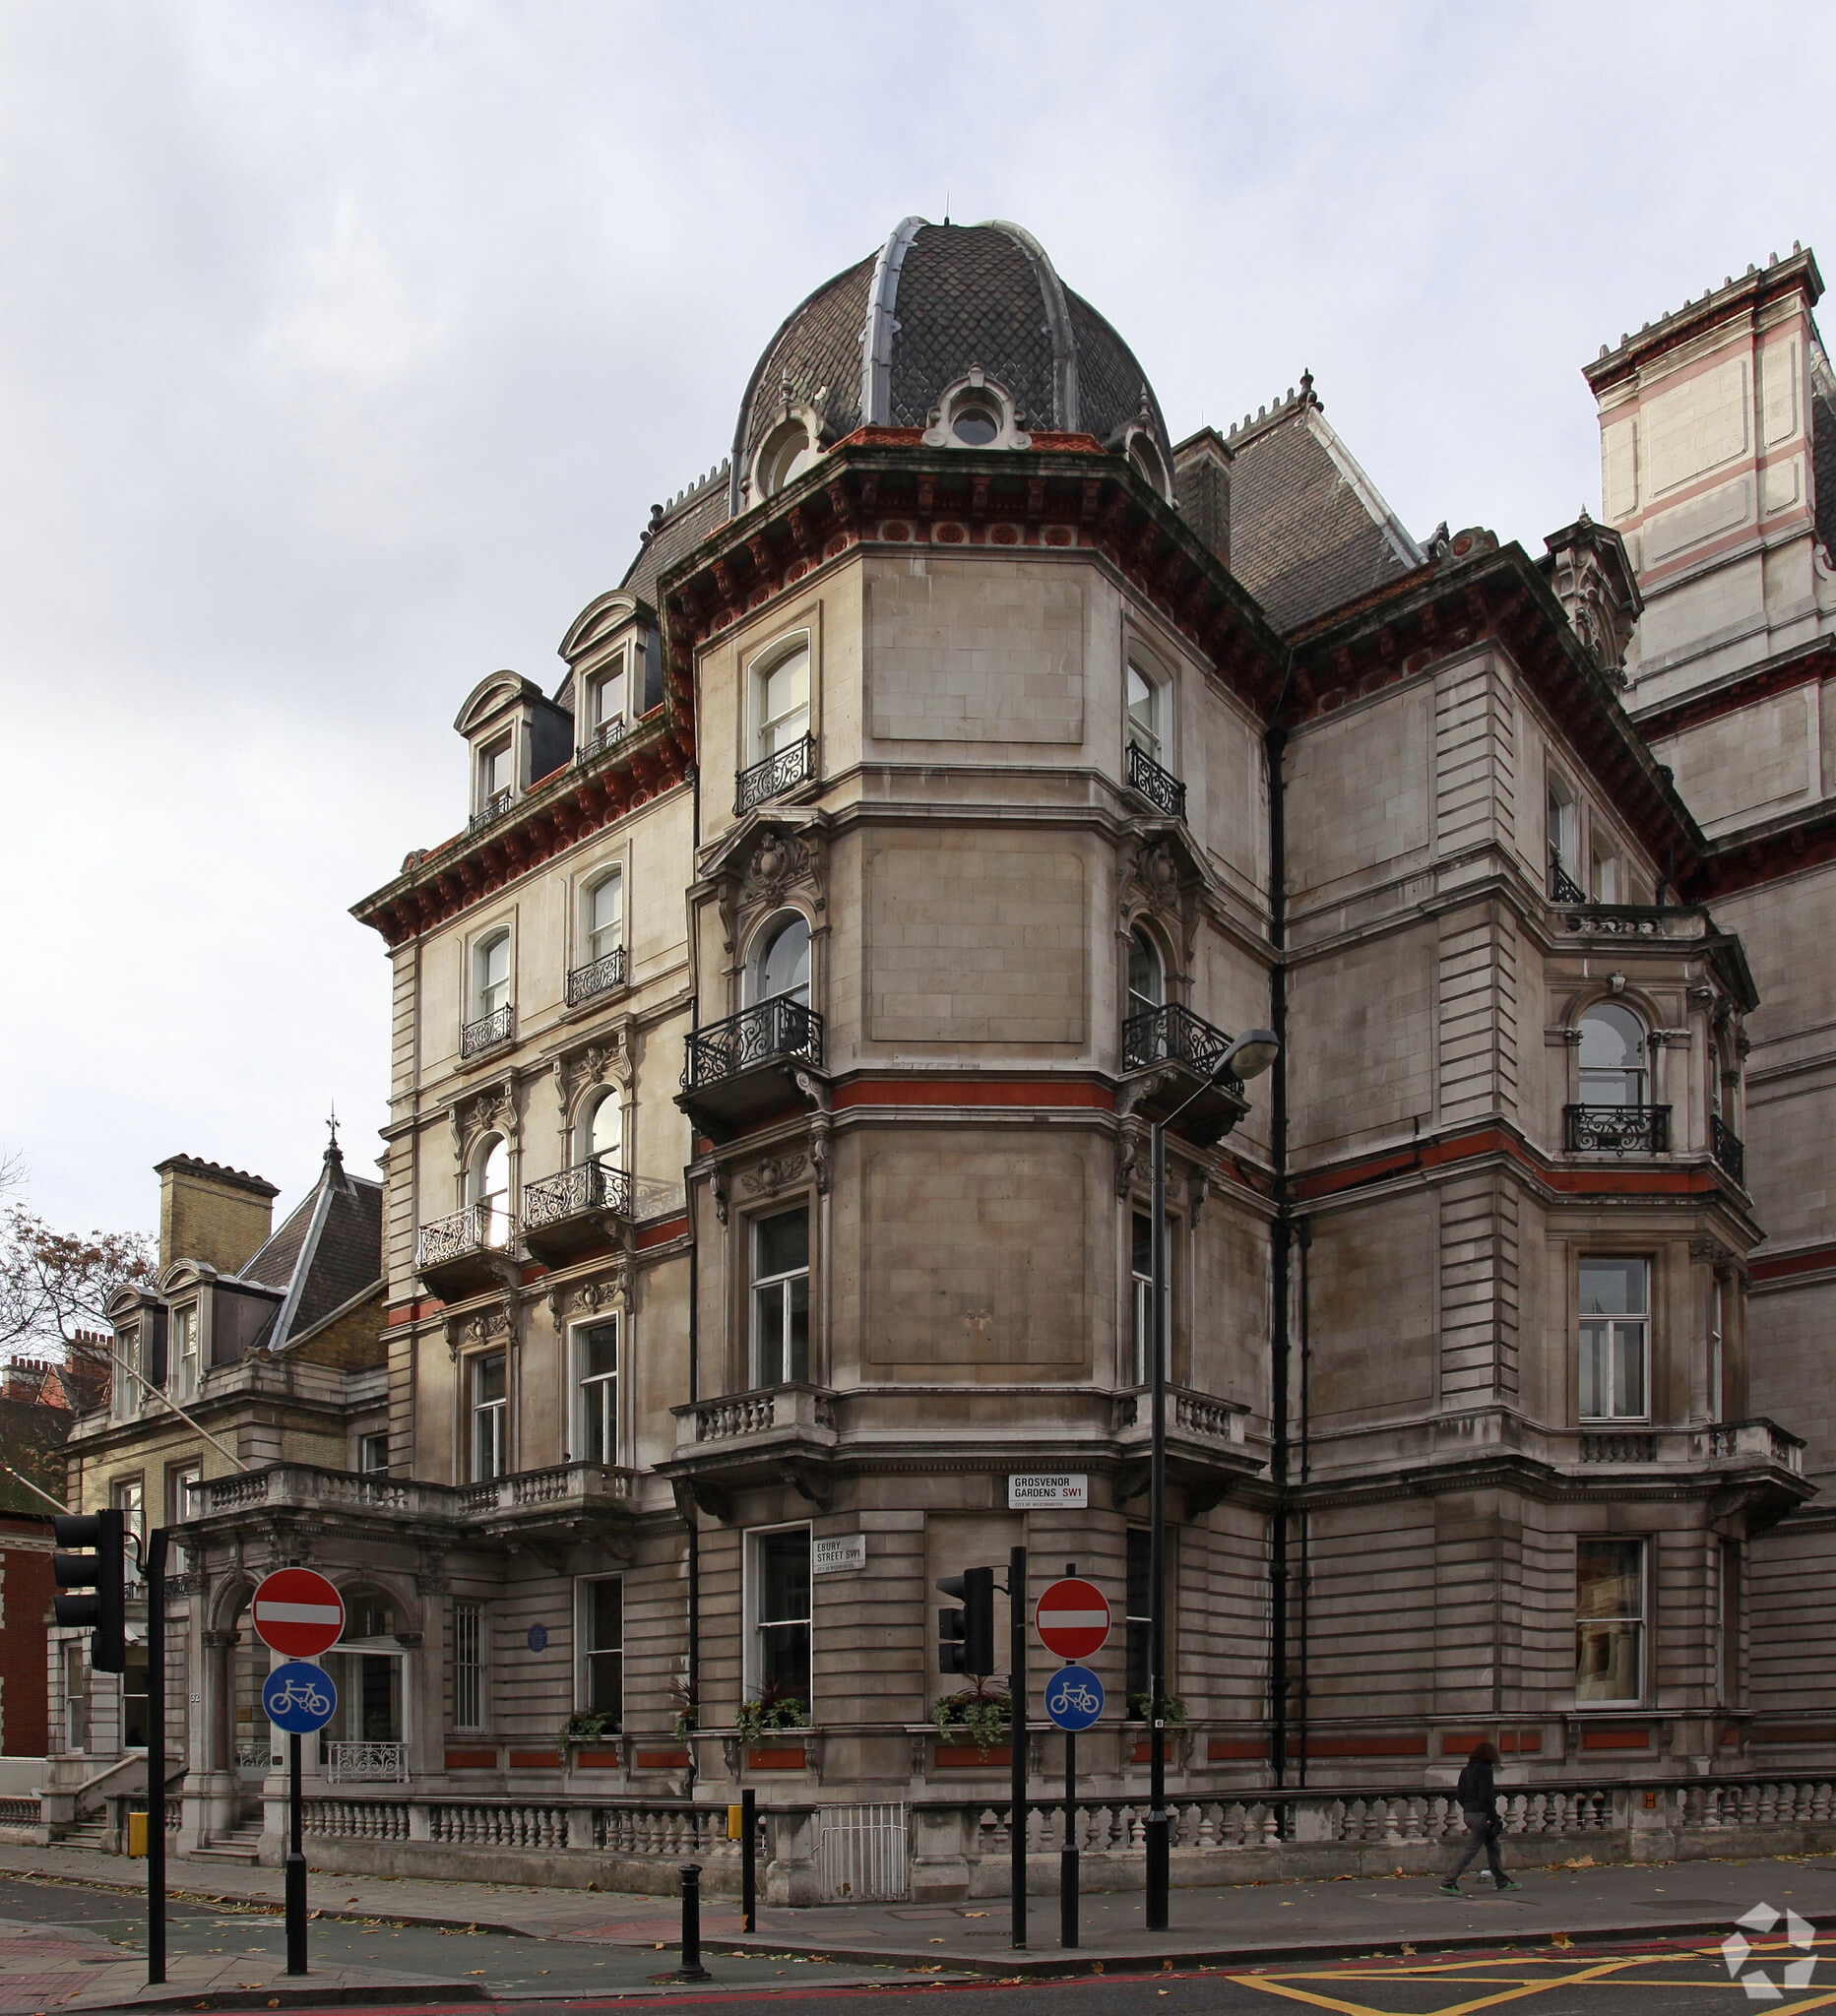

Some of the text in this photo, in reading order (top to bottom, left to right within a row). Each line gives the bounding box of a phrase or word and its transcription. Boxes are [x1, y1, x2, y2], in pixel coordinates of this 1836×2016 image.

[1014, 1477, 1070, 1487] GROSVENOR
[1014, 1487, 1082, 1497] GARDENS SW1
[817, 1541, 841, 1552] EBURY
[817, 1548, 860, 1562] STREET SW1
[190, 1692, 200, 1703] 32
